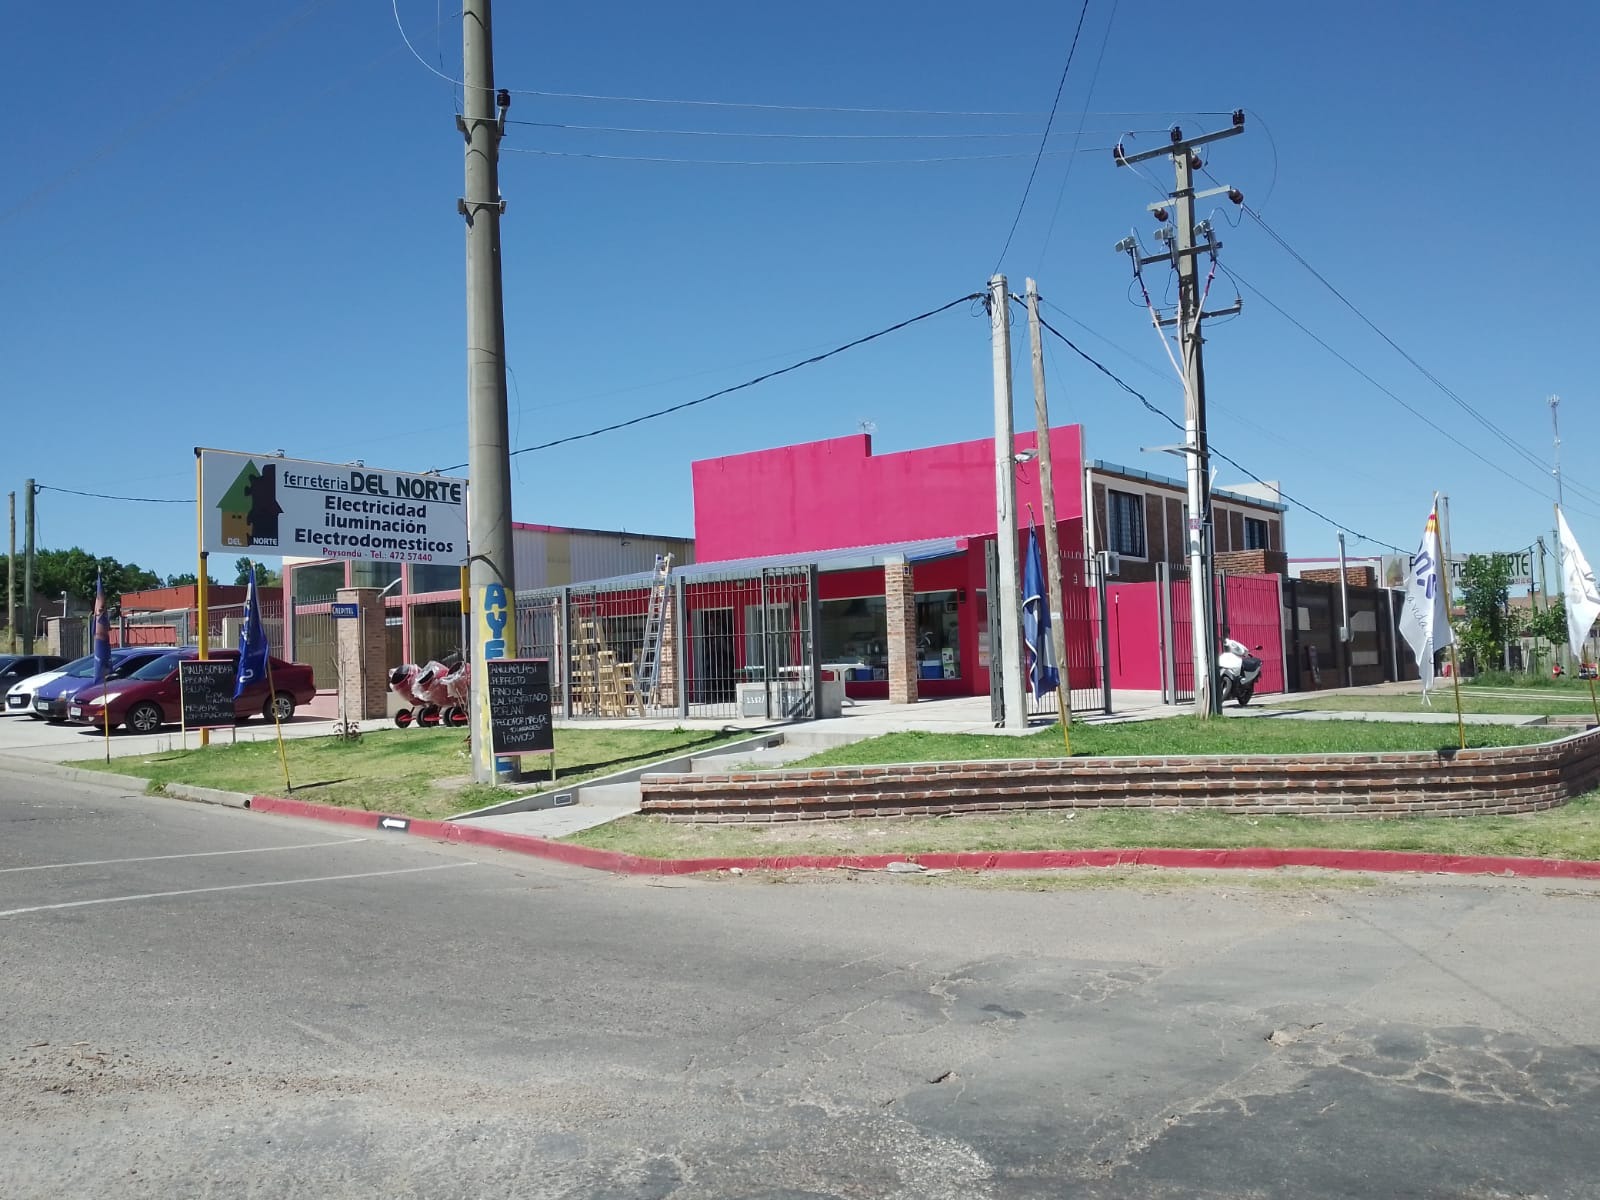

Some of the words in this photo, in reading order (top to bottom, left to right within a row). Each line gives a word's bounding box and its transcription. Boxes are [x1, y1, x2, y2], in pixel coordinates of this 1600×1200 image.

[283, 471, 349, 491] ferreteria
[350, 472, 389, 496] DEL
[396, 476, 462, 502] NORTE
[325, 495, 427, 518] Electricidad
[325, 512, 427, 535] iluminación
[227, 537, 241, 545] DEL
[253, 537, 278, 546] NORTE
[294, 528, 454, 553] Electrodomesticos
[322, 547, 362, 560] Paysandú
[389, 551, 405, 561] 472
[407, 552, 433, 562] 57440
